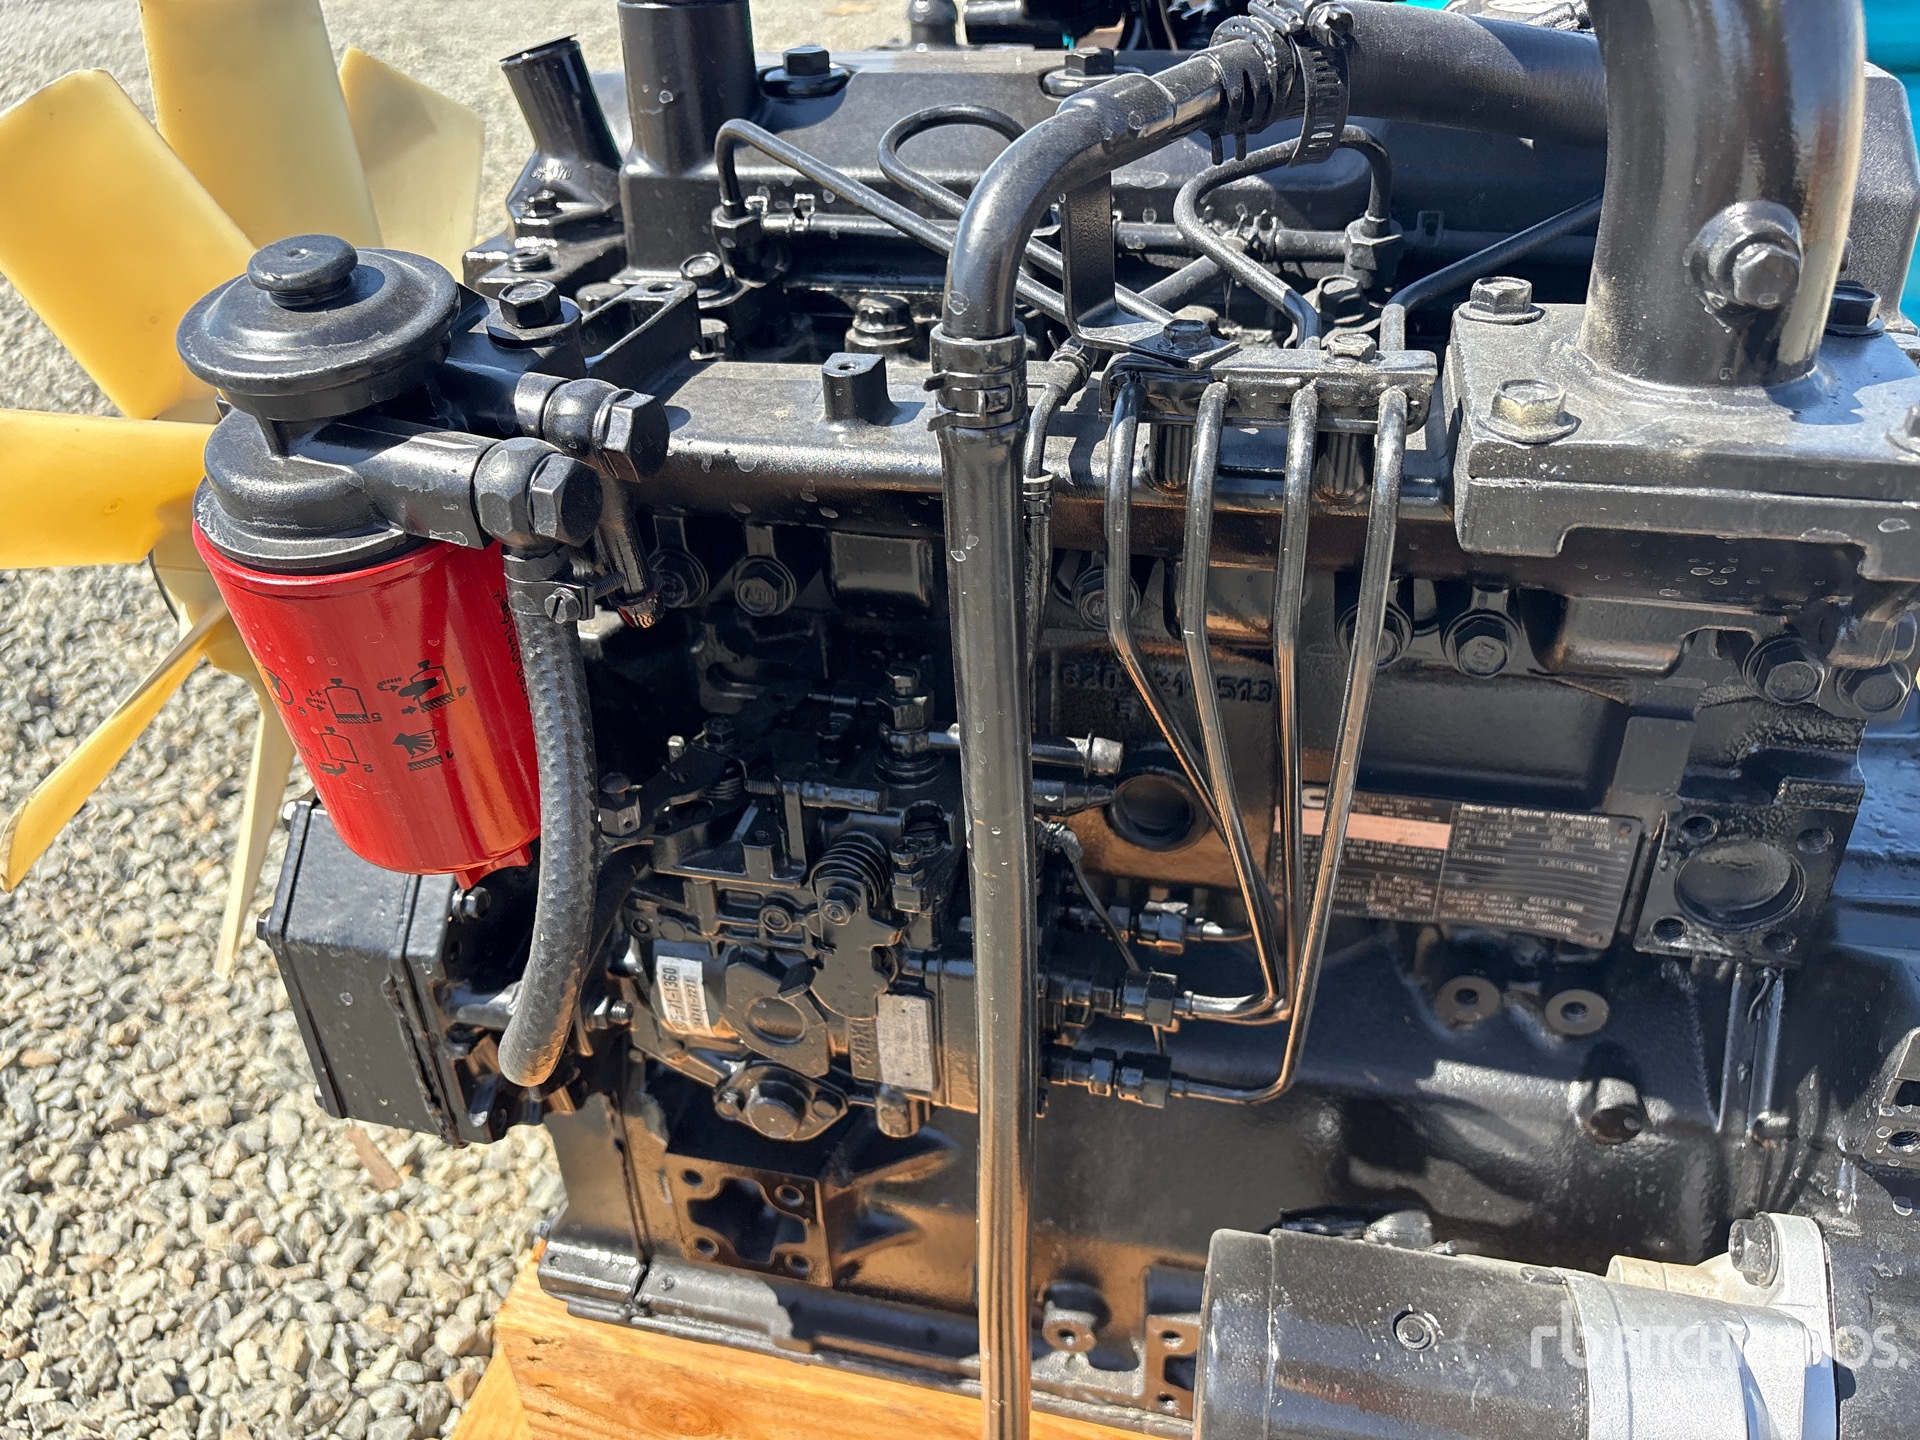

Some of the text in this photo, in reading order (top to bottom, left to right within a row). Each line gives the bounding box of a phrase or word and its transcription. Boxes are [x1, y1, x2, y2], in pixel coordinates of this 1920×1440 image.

[371, 712, 383, 723] 5
[362, 763, 374, 774] 2
[1511, 807, 1545, 819] Engine
[1550, 811, 1609, 825] Information
